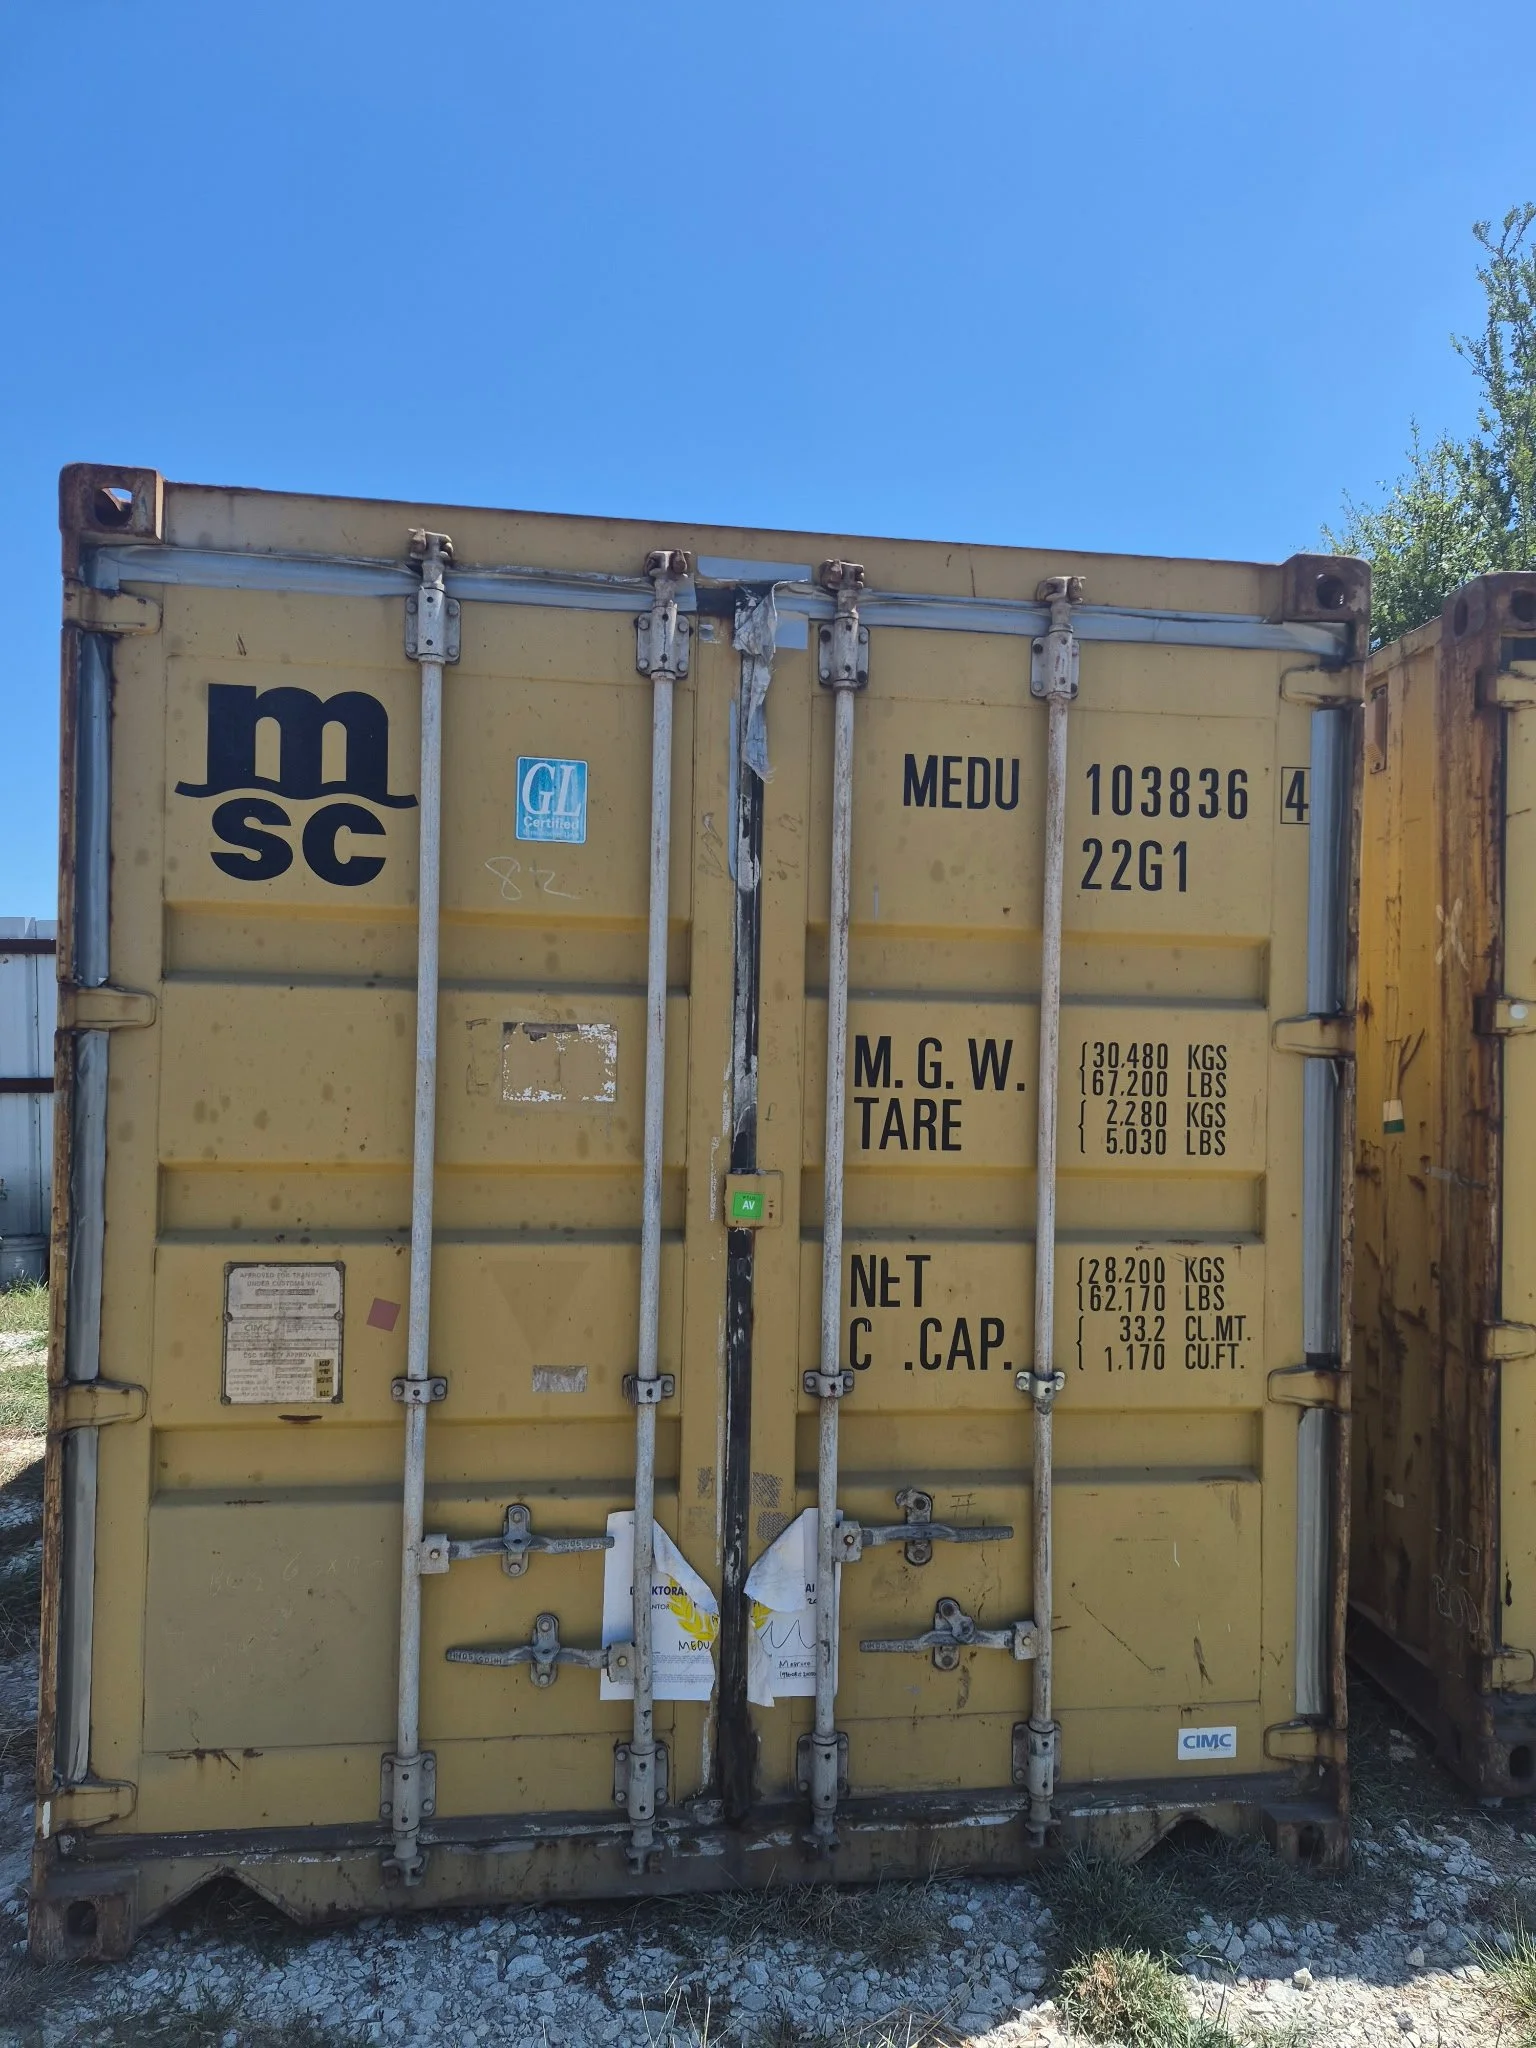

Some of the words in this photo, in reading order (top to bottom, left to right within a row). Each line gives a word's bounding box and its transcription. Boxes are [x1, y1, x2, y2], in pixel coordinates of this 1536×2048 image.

[522, 762, 582, 817] GL
[904, 753, 1020, 811] MEDU
[1086, 763, 1249, 820] 103836
[1285, 770, 1310, 822] 4
[523, 815, 579, 829] Certified
[1080, 838, 1188, 893] 22G1
[1092, 1041, 1169, 1070] 30,480
[1187, 1044, 1228, 1071] KGS
[1092, 1069, 1168, 1098] 67,200
[1187, 1071, 1227, 1098] LBS
[853, 1096, 963, 1151] TARE
[1106, 1098, 1167, 1128] 2,280
[1186, 1101, 1226, 1129] KGS
[1106, 1127, 1167, 1156] 5,030
[1186, 1129, 1226, 1156] LBS
[742, 1200, 755, 1210] AV
[850, 1254, 931, 1308] NET
[1088, 1256, 1166, 1284] 28,200
[1184, 1256, 1225, 1284] KGS
[1090, 1284, 1166, 1312] 62,170
[1184, 1284, 1225, 1312] LBS
[1119, 1315, 1166, 1342] 33.2
[1104, 1343, 1166, 1372] 1,170
[1184, 1342, 1245, 1370] CU.FT.
[678, 1640, 710, 1652] MEDU
[1183, 1733, 1232, 1749] CIMC
